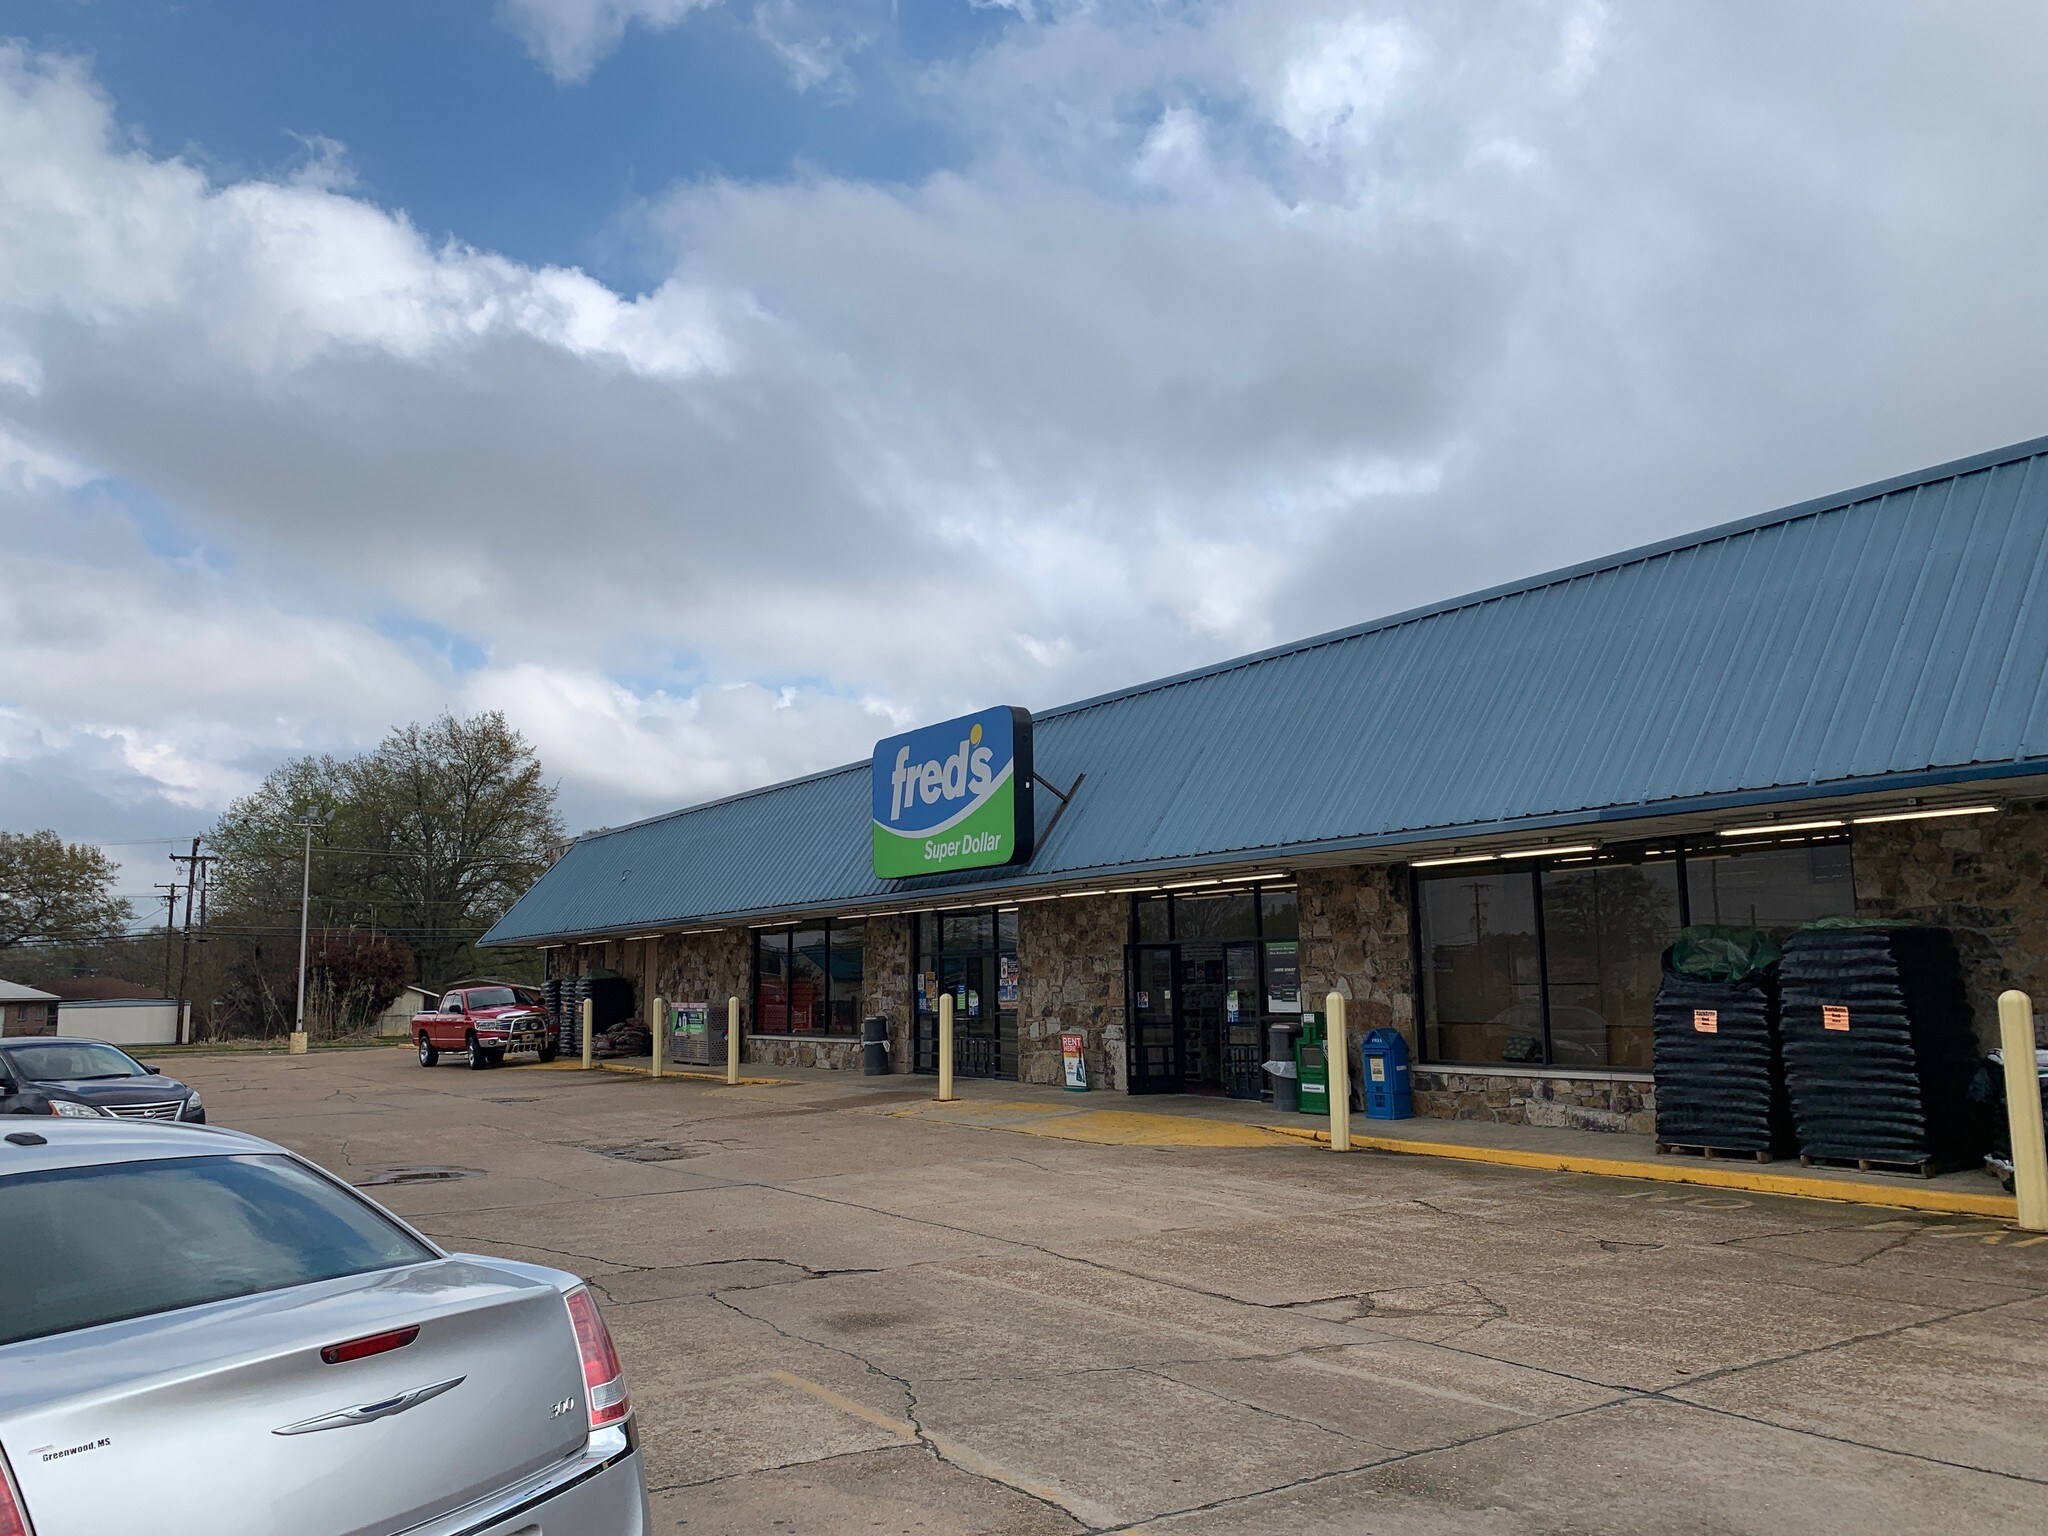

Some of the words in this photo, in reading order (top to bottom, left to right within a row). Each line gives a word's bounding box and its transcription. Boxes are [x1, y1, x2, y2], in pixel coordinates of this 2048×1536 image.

[890, 723, 994, 821] fred's
[924, 838, 961, 862] Super
[962, 832, 1002, 855] Dollar
[1062, 1036, 1081, 1047] RENT
[549, 1396, 575, 1420] 300
